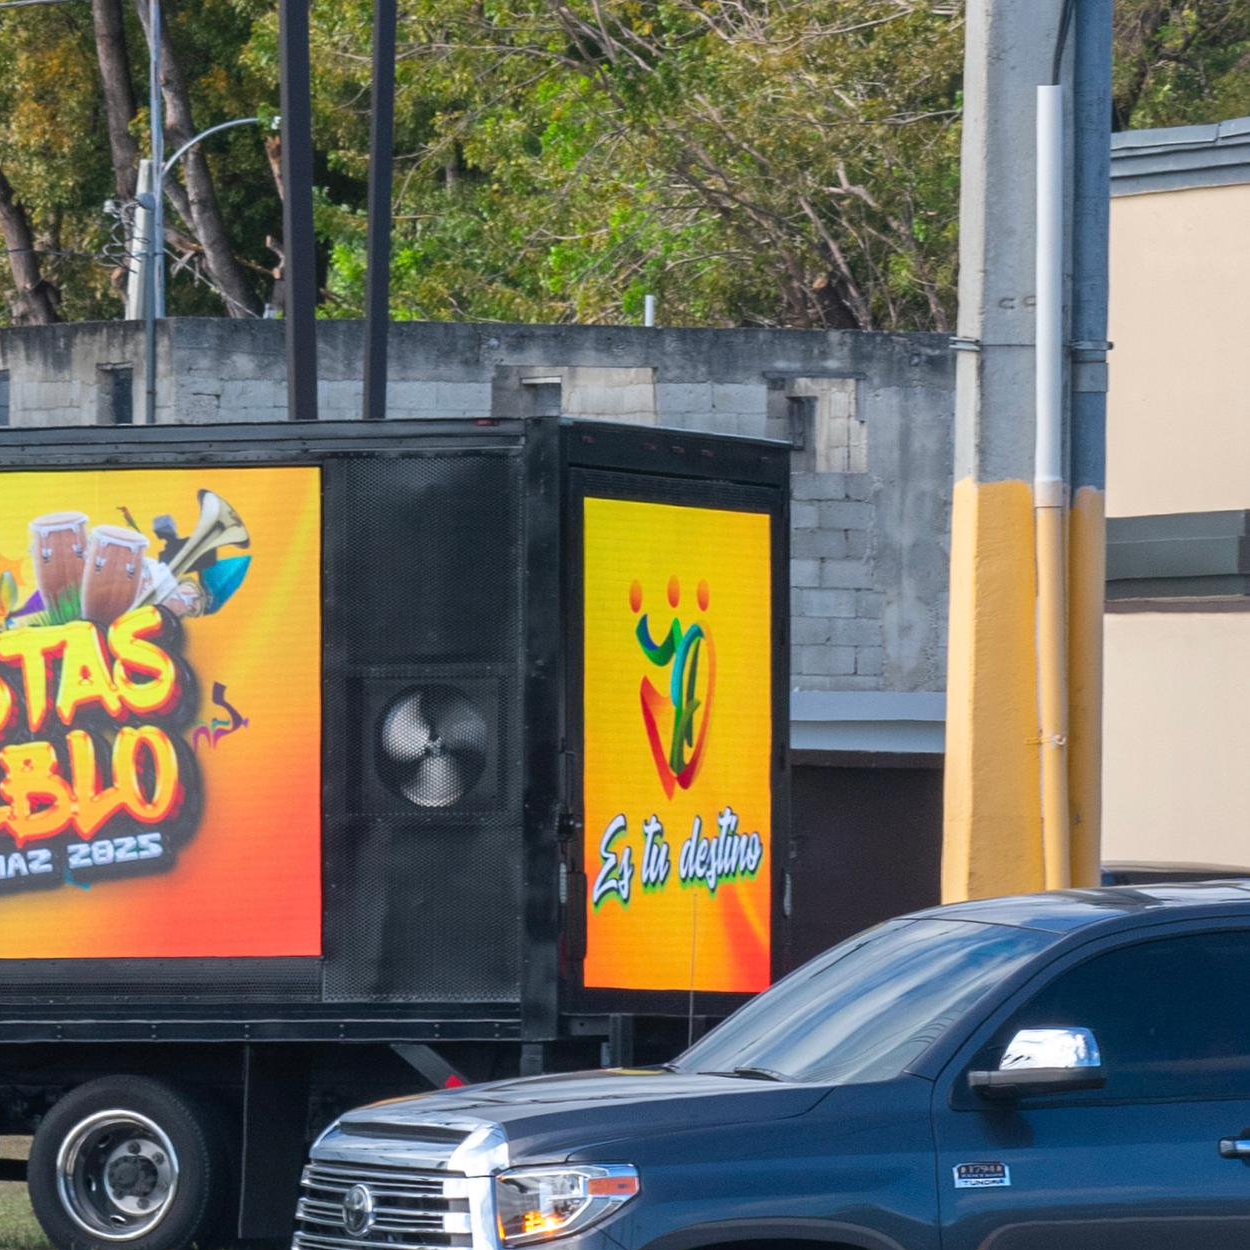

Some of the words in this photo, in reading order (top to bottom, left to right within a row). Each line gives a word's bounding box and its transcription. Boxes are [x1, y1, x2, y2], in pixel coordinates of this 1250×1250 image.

[67, 832, 164, 869] 2025
[592, 813, 634, 908] Es
[641, 814, 671, 886] tu
[679, 806, 762, 894] destino
